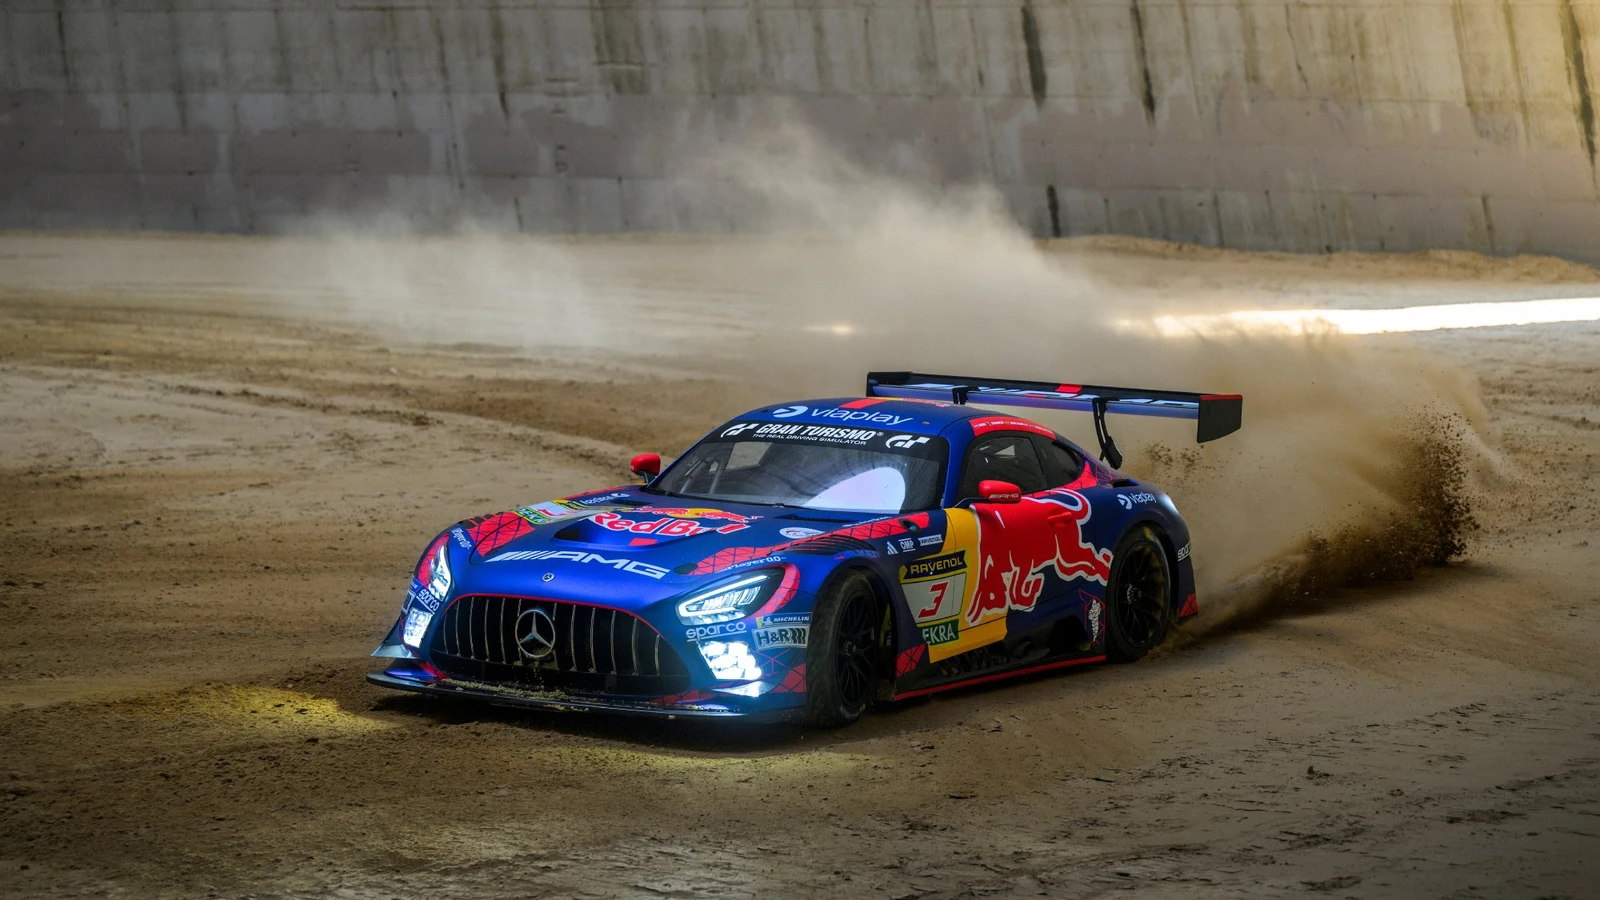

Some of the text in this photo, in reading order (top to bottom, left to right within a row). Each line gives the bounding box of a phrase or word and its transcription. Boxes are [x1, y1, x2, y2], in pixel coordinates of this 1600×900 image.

[811, 408, 914, 425] viaplay
[756, 423, 804, 435] GRAN
[819, 437, 867, 445] SIMULATOR
[538, 551, 670, 580] AMG
[909, 557, 963, 575] RAVENOL
[418, 588, 440, 612] sparco
[917, 581, 949, 619] 3
[686, 621, 747, 641] sparco
[922, 623, 956, 644] EKRA
